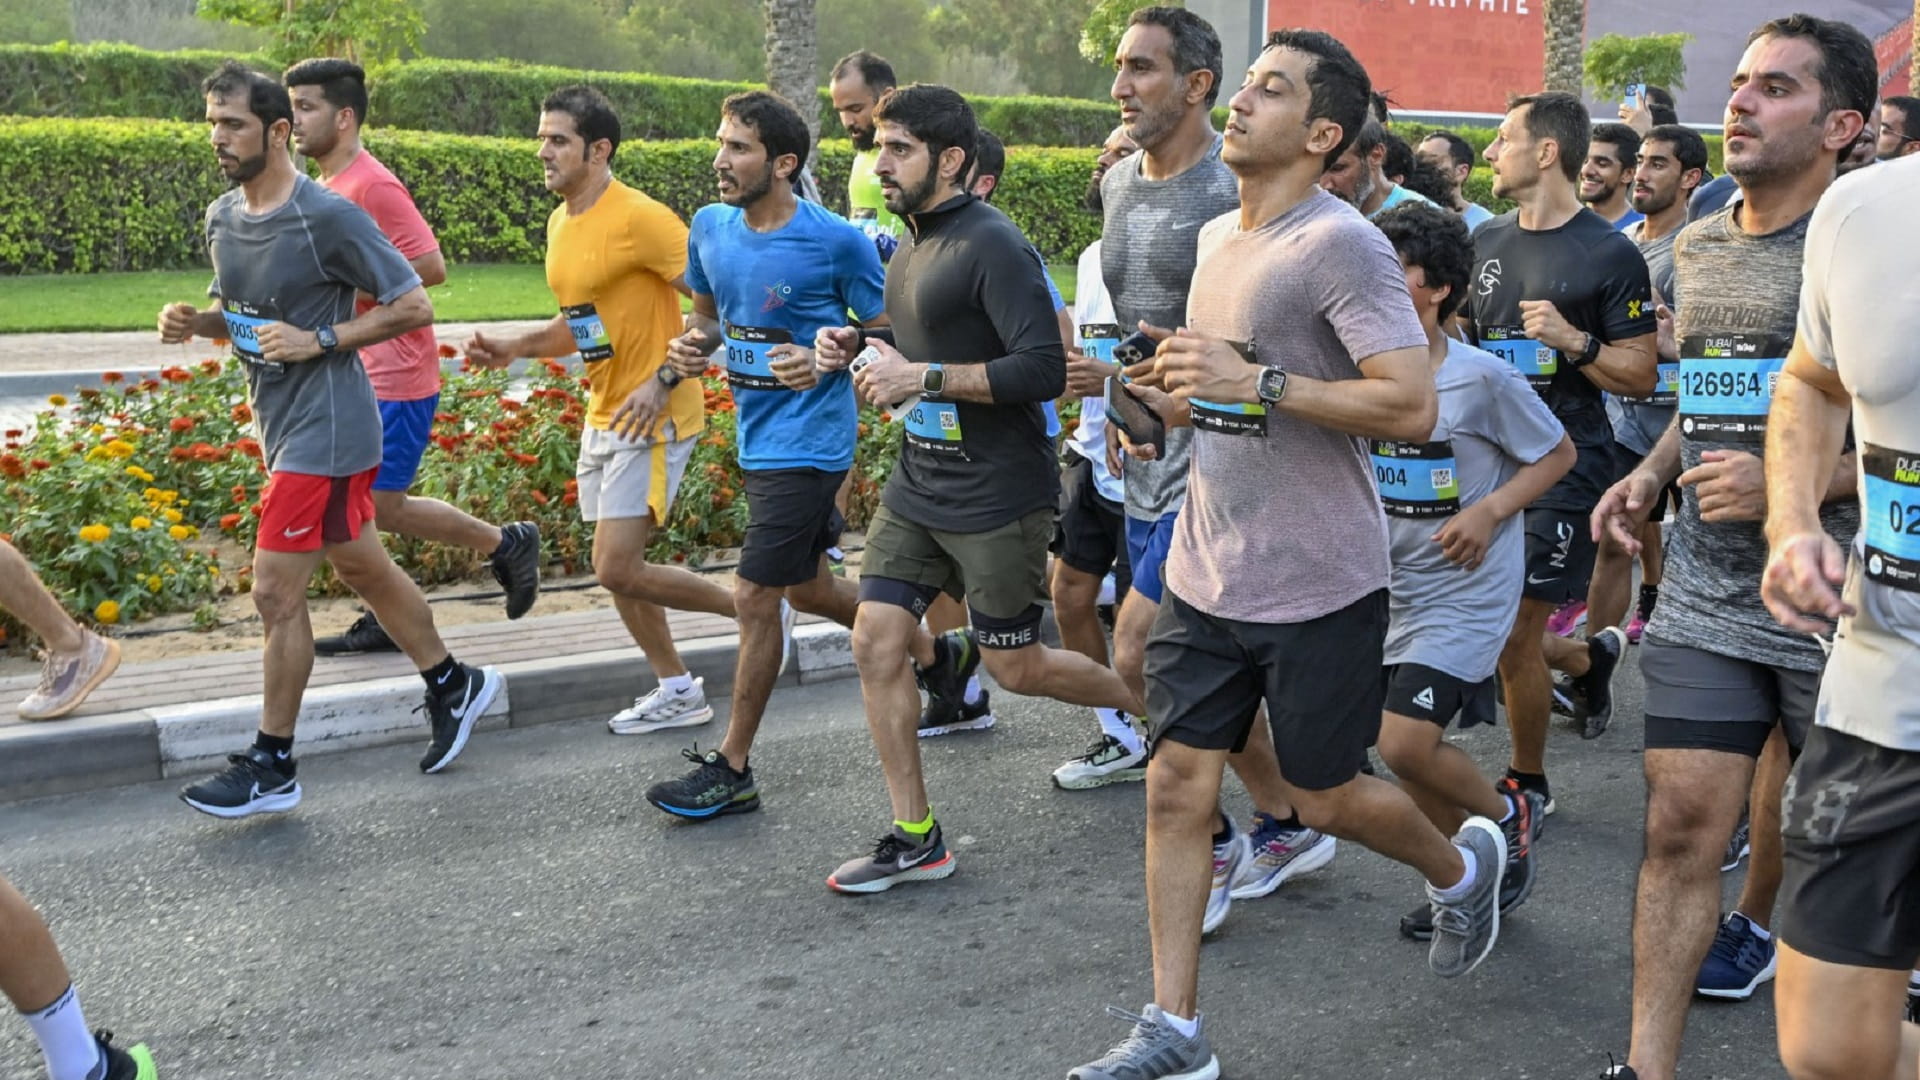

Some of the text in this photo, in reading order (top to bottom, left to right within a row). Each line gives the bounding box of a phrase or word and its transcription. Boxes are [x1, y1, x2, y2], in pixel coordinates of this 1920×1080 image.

[1705, 338, 1733, 348] DUBAI
[728, 345, 755, 365] 018
[1682, 371, 1763, 397] 126954
[1376, 465, 1408, 487] 004
[1889, 500, 1920, 535] 02
[978, 628, 1032, 646] EATHE
